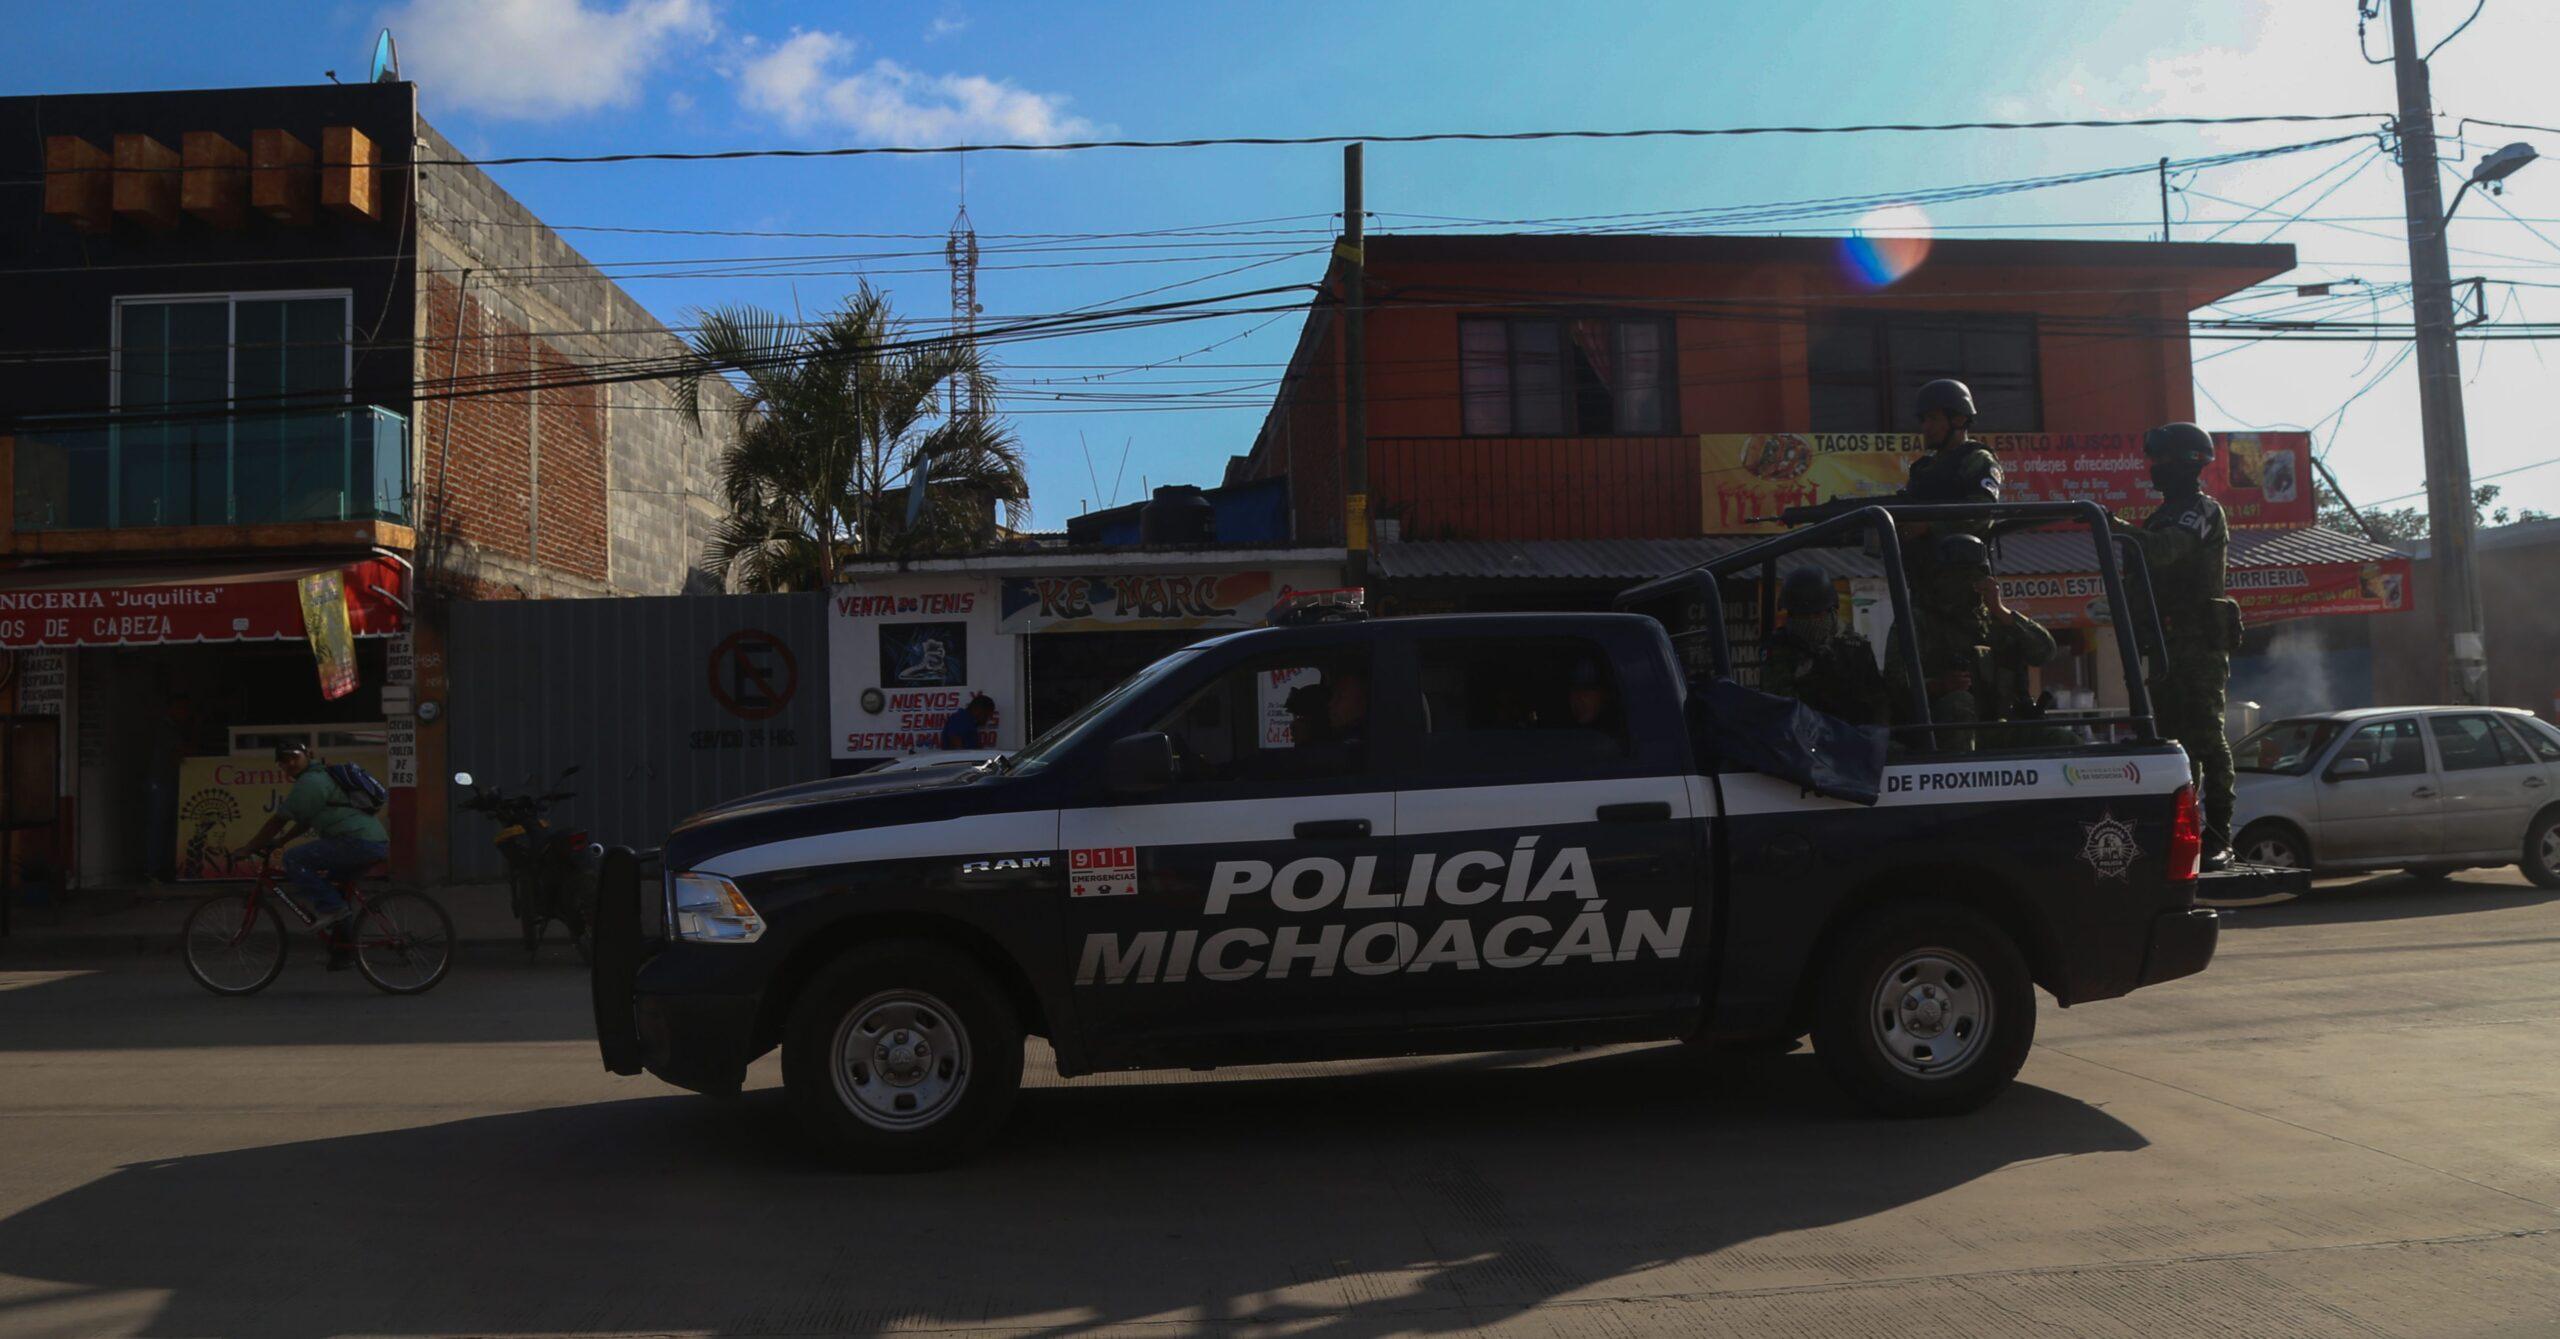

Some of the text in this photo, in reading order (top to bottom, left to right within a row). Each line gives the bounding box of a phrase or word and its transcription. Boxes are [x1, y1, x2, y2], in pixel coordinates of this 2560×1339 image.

[1814, 434, 1869, 452] TACOS
[1875, 435, 1896, 452] DE
[1995, 434, 2051, 453] ESTILO
[2056, 433, 2121, 451] JALISCO
[837, 594, 897, 617] VENTA
[920, 592, 976, 614] TENIS
[45, 618, 70, 638] DE
[94, 615, 173, 637] CABEZA
[888, 691, 960, 712] NUEVOS
[847, 732, 915, 752] SISTEMA
[1887, 769, 2039, 793] DE PROXIMIDAD
[962, 856, 1051, 875] RAM
[1203, 836, 1601, 915] POLICÍA
[1072, 872, 1137, 883] EMERGENCIAS
[1074, 898, 1692, 986] MICHOACÁN
